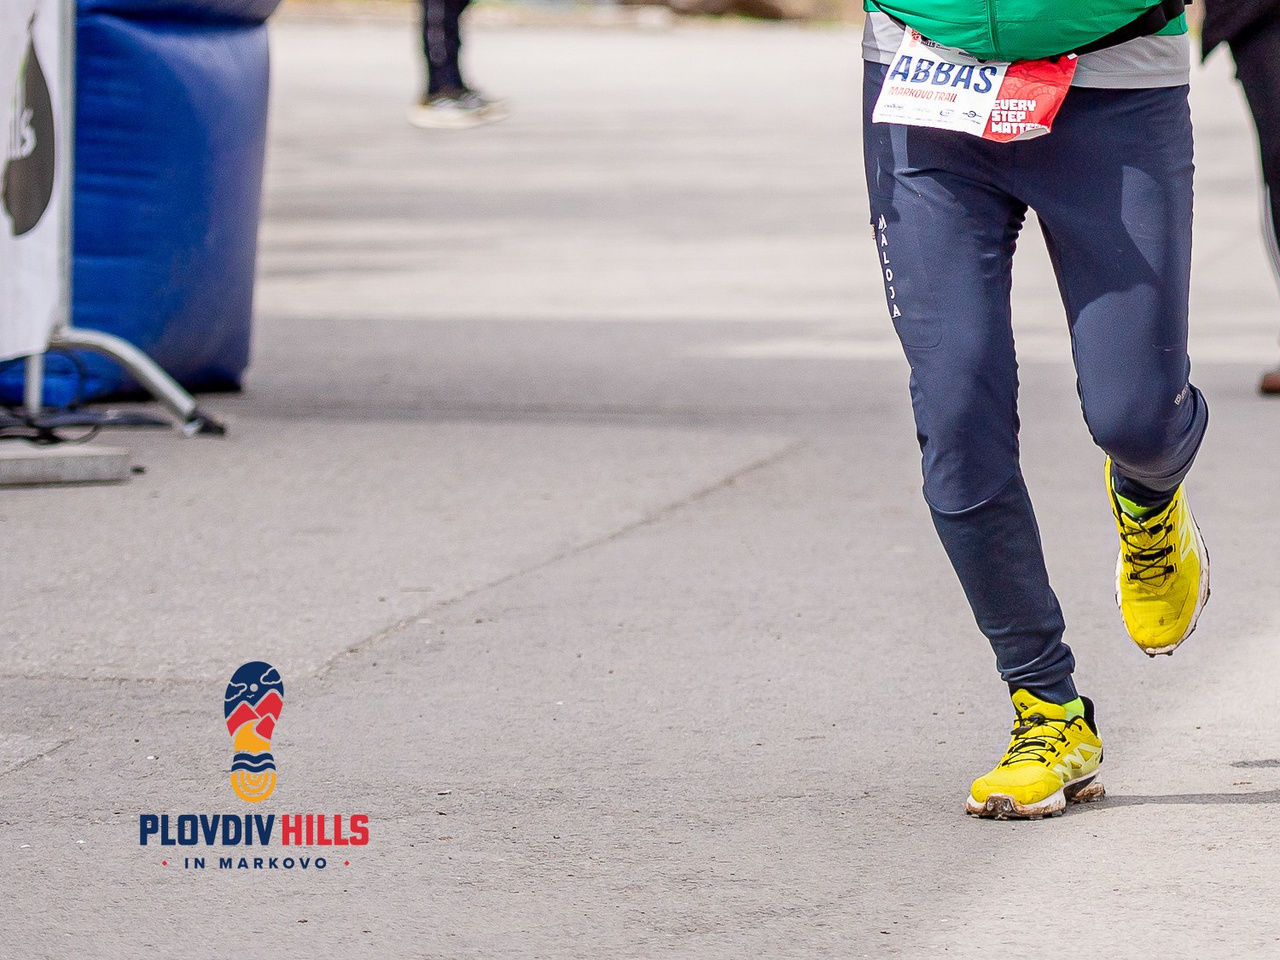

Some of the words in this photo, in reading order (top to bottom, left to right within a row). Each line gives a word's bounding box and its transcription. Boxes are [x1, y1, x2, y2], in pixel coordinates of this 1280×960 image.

[888, 54, 998, 94] ABBAS
[887, 86, 934, 100] MARKOVO
[933, 90, 958, 104] TRAIL
[993, 98, 1037, 112] EVERY
[991, 110, 1026, 123] STEP
[878, 213, 902, 319] MALOJA
